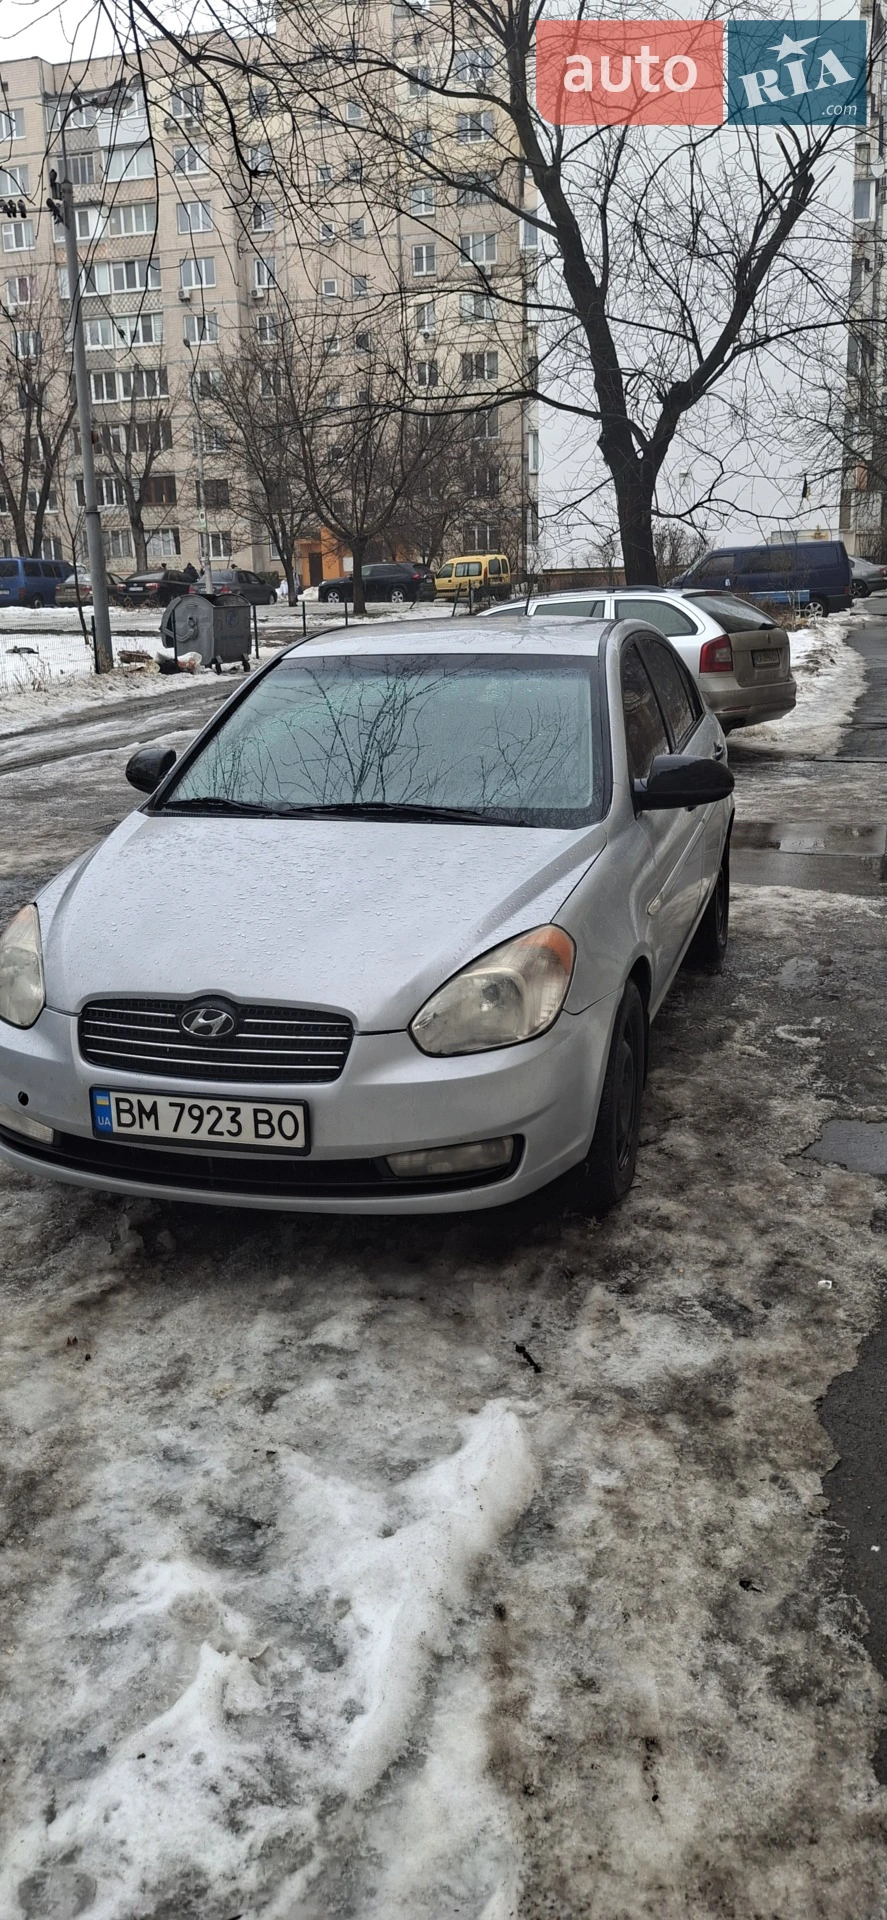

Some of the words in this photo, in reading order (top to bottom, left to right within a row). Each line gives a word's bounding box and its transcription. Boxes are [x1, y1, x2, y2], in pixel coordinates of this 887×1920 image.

[97, 1115, 111, 1127] UA
[115, 1096, 160, 1131] BM
[168, 1101, 243, 1138] 7923
[252, 1107, 300, 1141] BO
